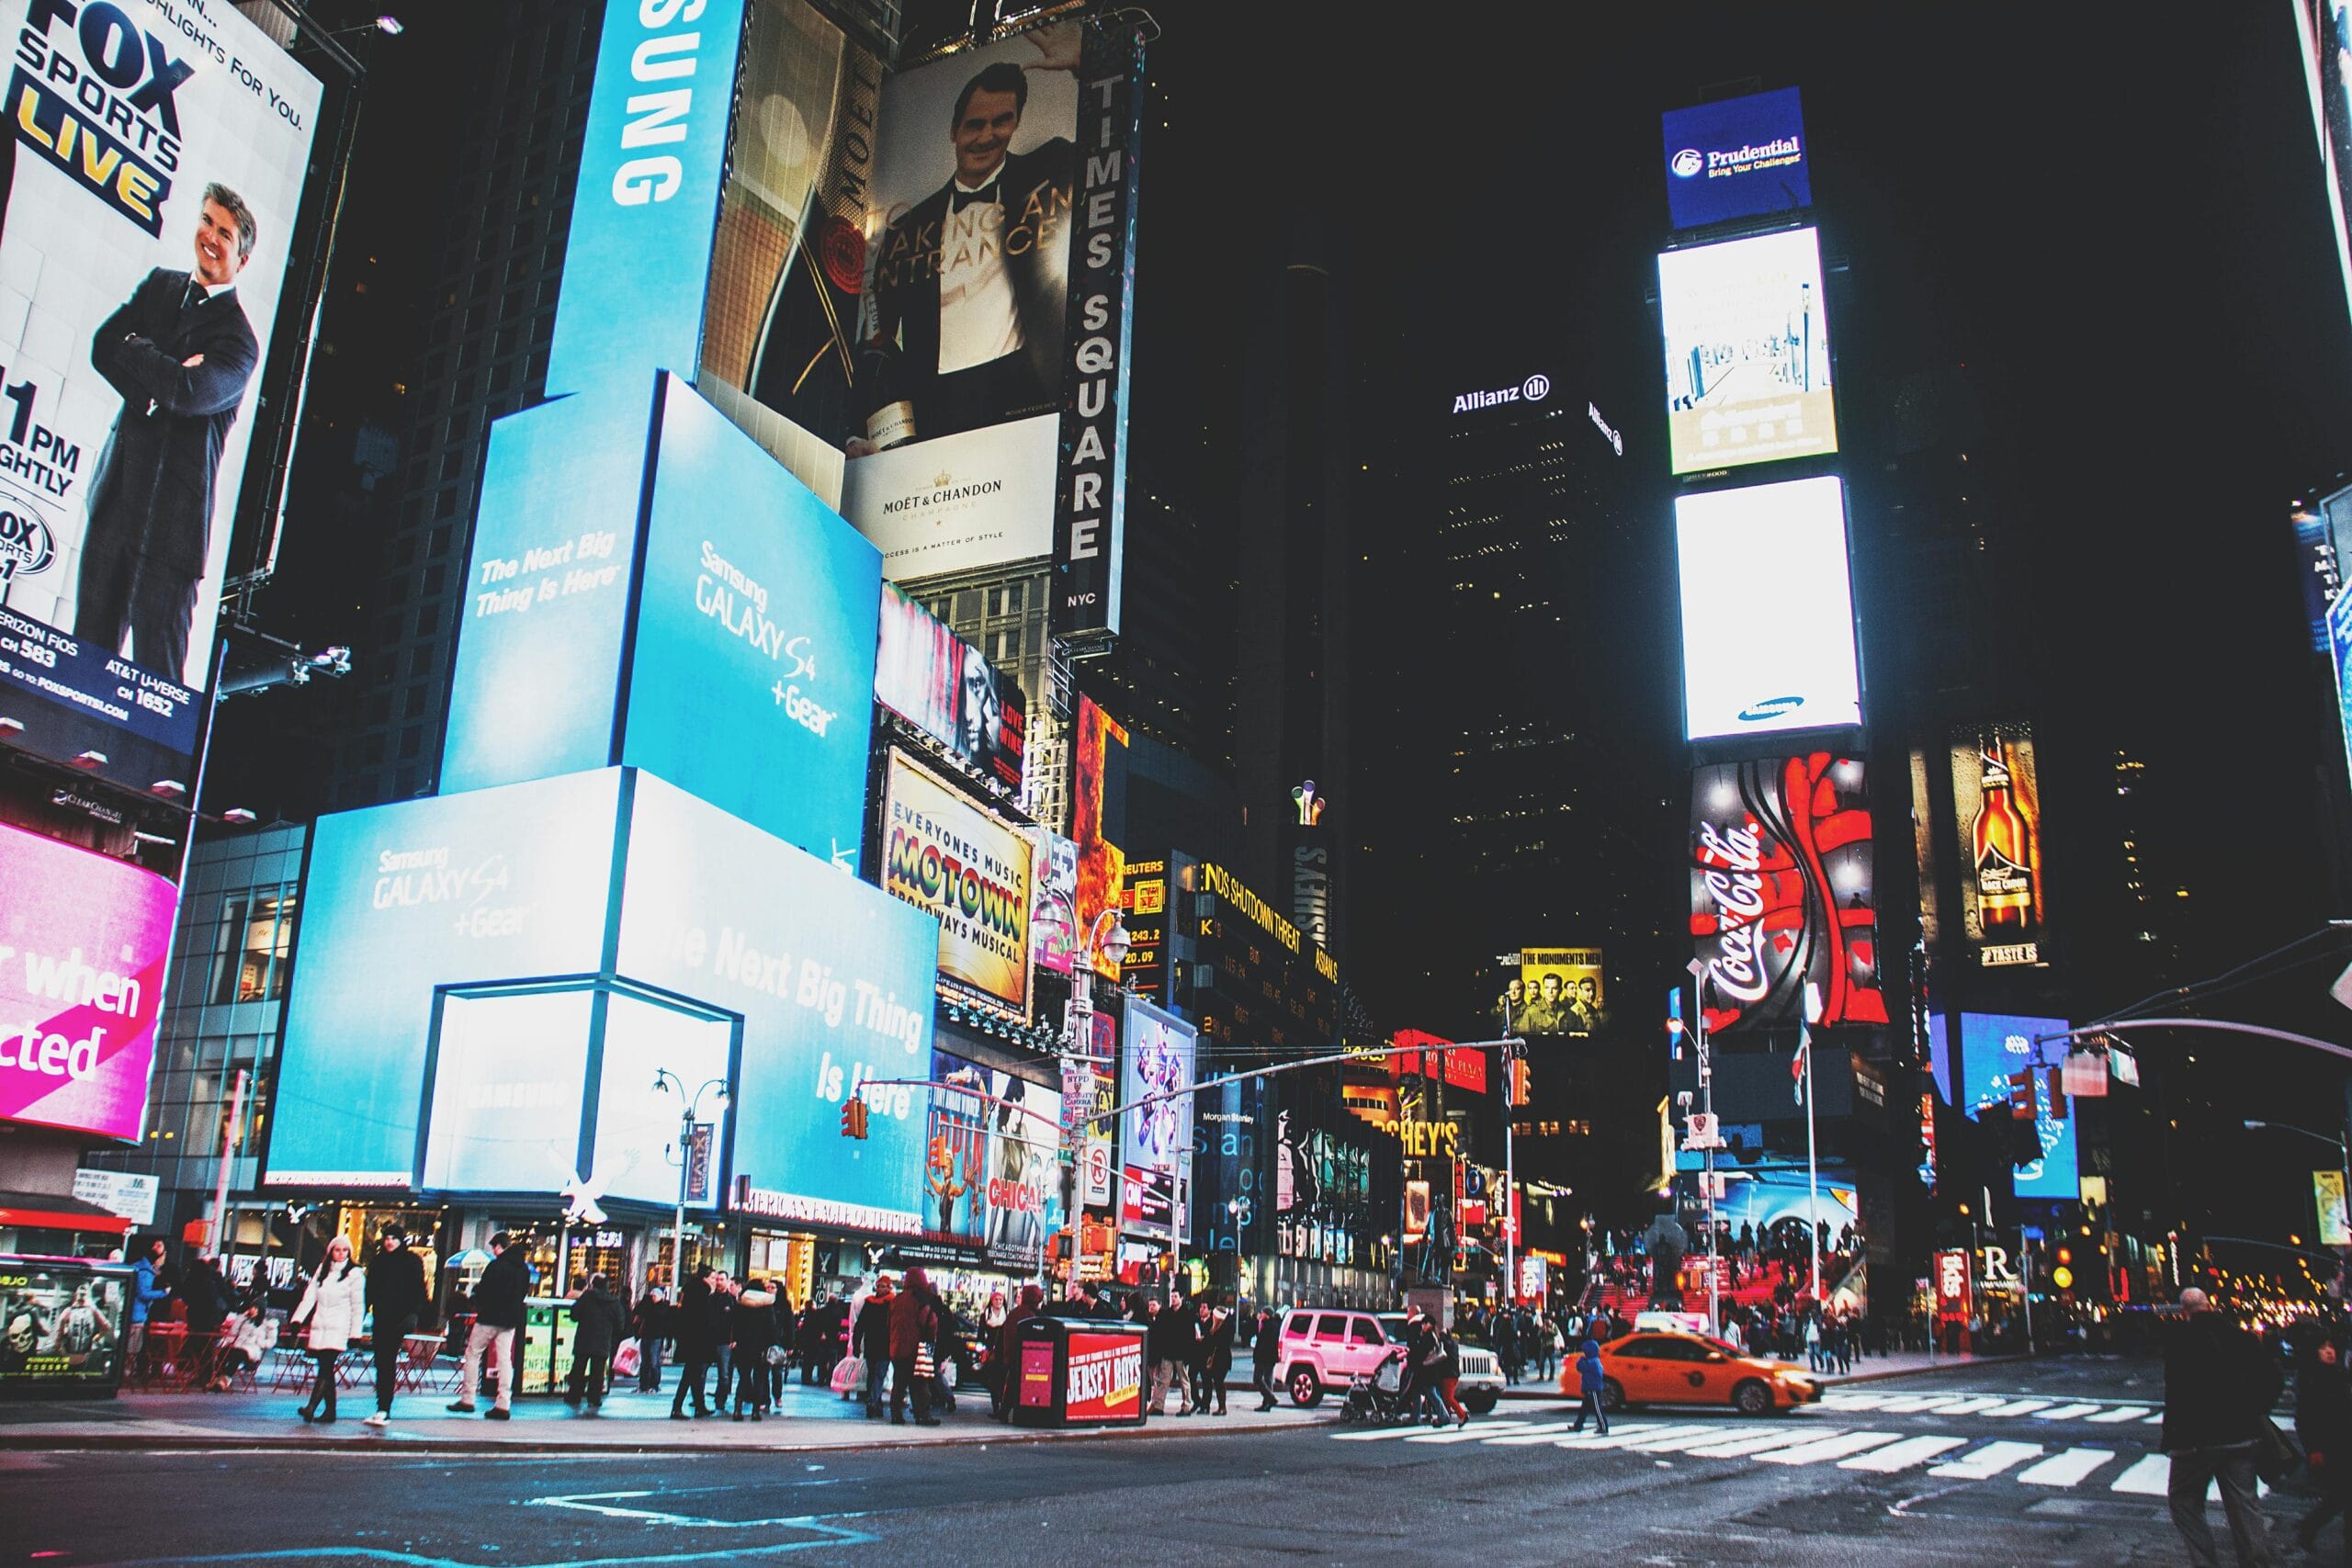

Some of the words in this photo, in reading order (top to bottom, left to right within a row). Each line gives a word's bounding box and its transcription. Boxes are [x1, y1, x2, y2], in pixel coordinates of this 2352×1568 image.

[16, 28, 183, 173] SPORTS
[230, 56, 264, 96] FOR
[268, 87, 303, 131] YOU.
[612, 0, 707, 206] SUNG
[17, 84, 161, 222] LIVE
[1085, 73, 1125, 269] TIMES
[1707, 136, 1801, 167] Prudential
[1708, 166, 1733, 178] Bring
[1734, 163, 1752, 173] Your
[1753, 153, 1801, 170] Challenges
[877, 216, 1059, 288] NTRANCE
[1453, 386, 1521, 413] Allianz
[1589, 400, 1613, 443] Allianz
[29, 423, 81, 474] PM
[1069, 293, 1114, 561] SQUARE
[901, 502, 978, 522] CHAMPAGNE
[922, 496, 930, 506] &
[933, 479, 1002, 503] CHANDON
[481, 558, 519, 585] The
[522, 539, 574, 574] Next
[576, 530, 616, 560] Big
[884, 548, 910, 558] CCESS
[911, 546, 920, 554] IS
[931, 538, 961, 549] MATTER
[965, 536, 975, 544] OF
[978, 531, 1003, 541] STYLE
[476, 586, 535, 618] Thing
[537, 577, 560, 603] Is
[561, 565, 618, 596] Here
[700, 539, 768, 615] Samsung
[1067, 592, 1097, 607] NYC
[47, 633, 79, 657] FiOS
[695, 573, 786, 661] GALAXY
[783, 636, 817, 682] S4
[12, 669, 25, 679] GO
[19, 639, 57, 668] 583
[105, 659, 140, 682] AT&T
[140, 672, 191, 705] U-VERSE
[117, 686, 134, 701] CH
[136, 688, 175, 717] 1652
[771, 679, 832, 739] +Gear
[1001, 700, 1023, 731] LOVE
[378, 846, 449, 874] Samsung
[894, 801, 978, 863] EVERYONE'S
[985, 853, 1024, 891] MUSIC.
[373, 866, 470, 909] GALAXY
[888, 826, 1022, 942] MOTOWN
[1230, 876, 1274, 937] SHUTDOWN
[1273, 912, 1302, 956] THREAT
[1523, 953, 1536, 964] THE
[1537, 953, 1584, 964] MONUMENTS
[25, 948, 141, 1019] when
[714, 926, 792, 999] Next
[796, 958, 847, 1028] Big
[854, 978, 924, 1055] Thing
[815, 1051, 844, 1102] Is
[850, 1061, 912, 1121] Here
[1068, 1075, 1090, 1083] NYPD
[1203, 1112, 1230, 1122] Morgan
[1231, 1113, 1255, 1125] Stanley
[1941, 1254, 1964, 1298] tkts
[1984, 1247, 2019, 1280] R
[1067, 1359, 1111, 1404] JERSEY
[1114, 1353, 1142, 1392] BOYS
